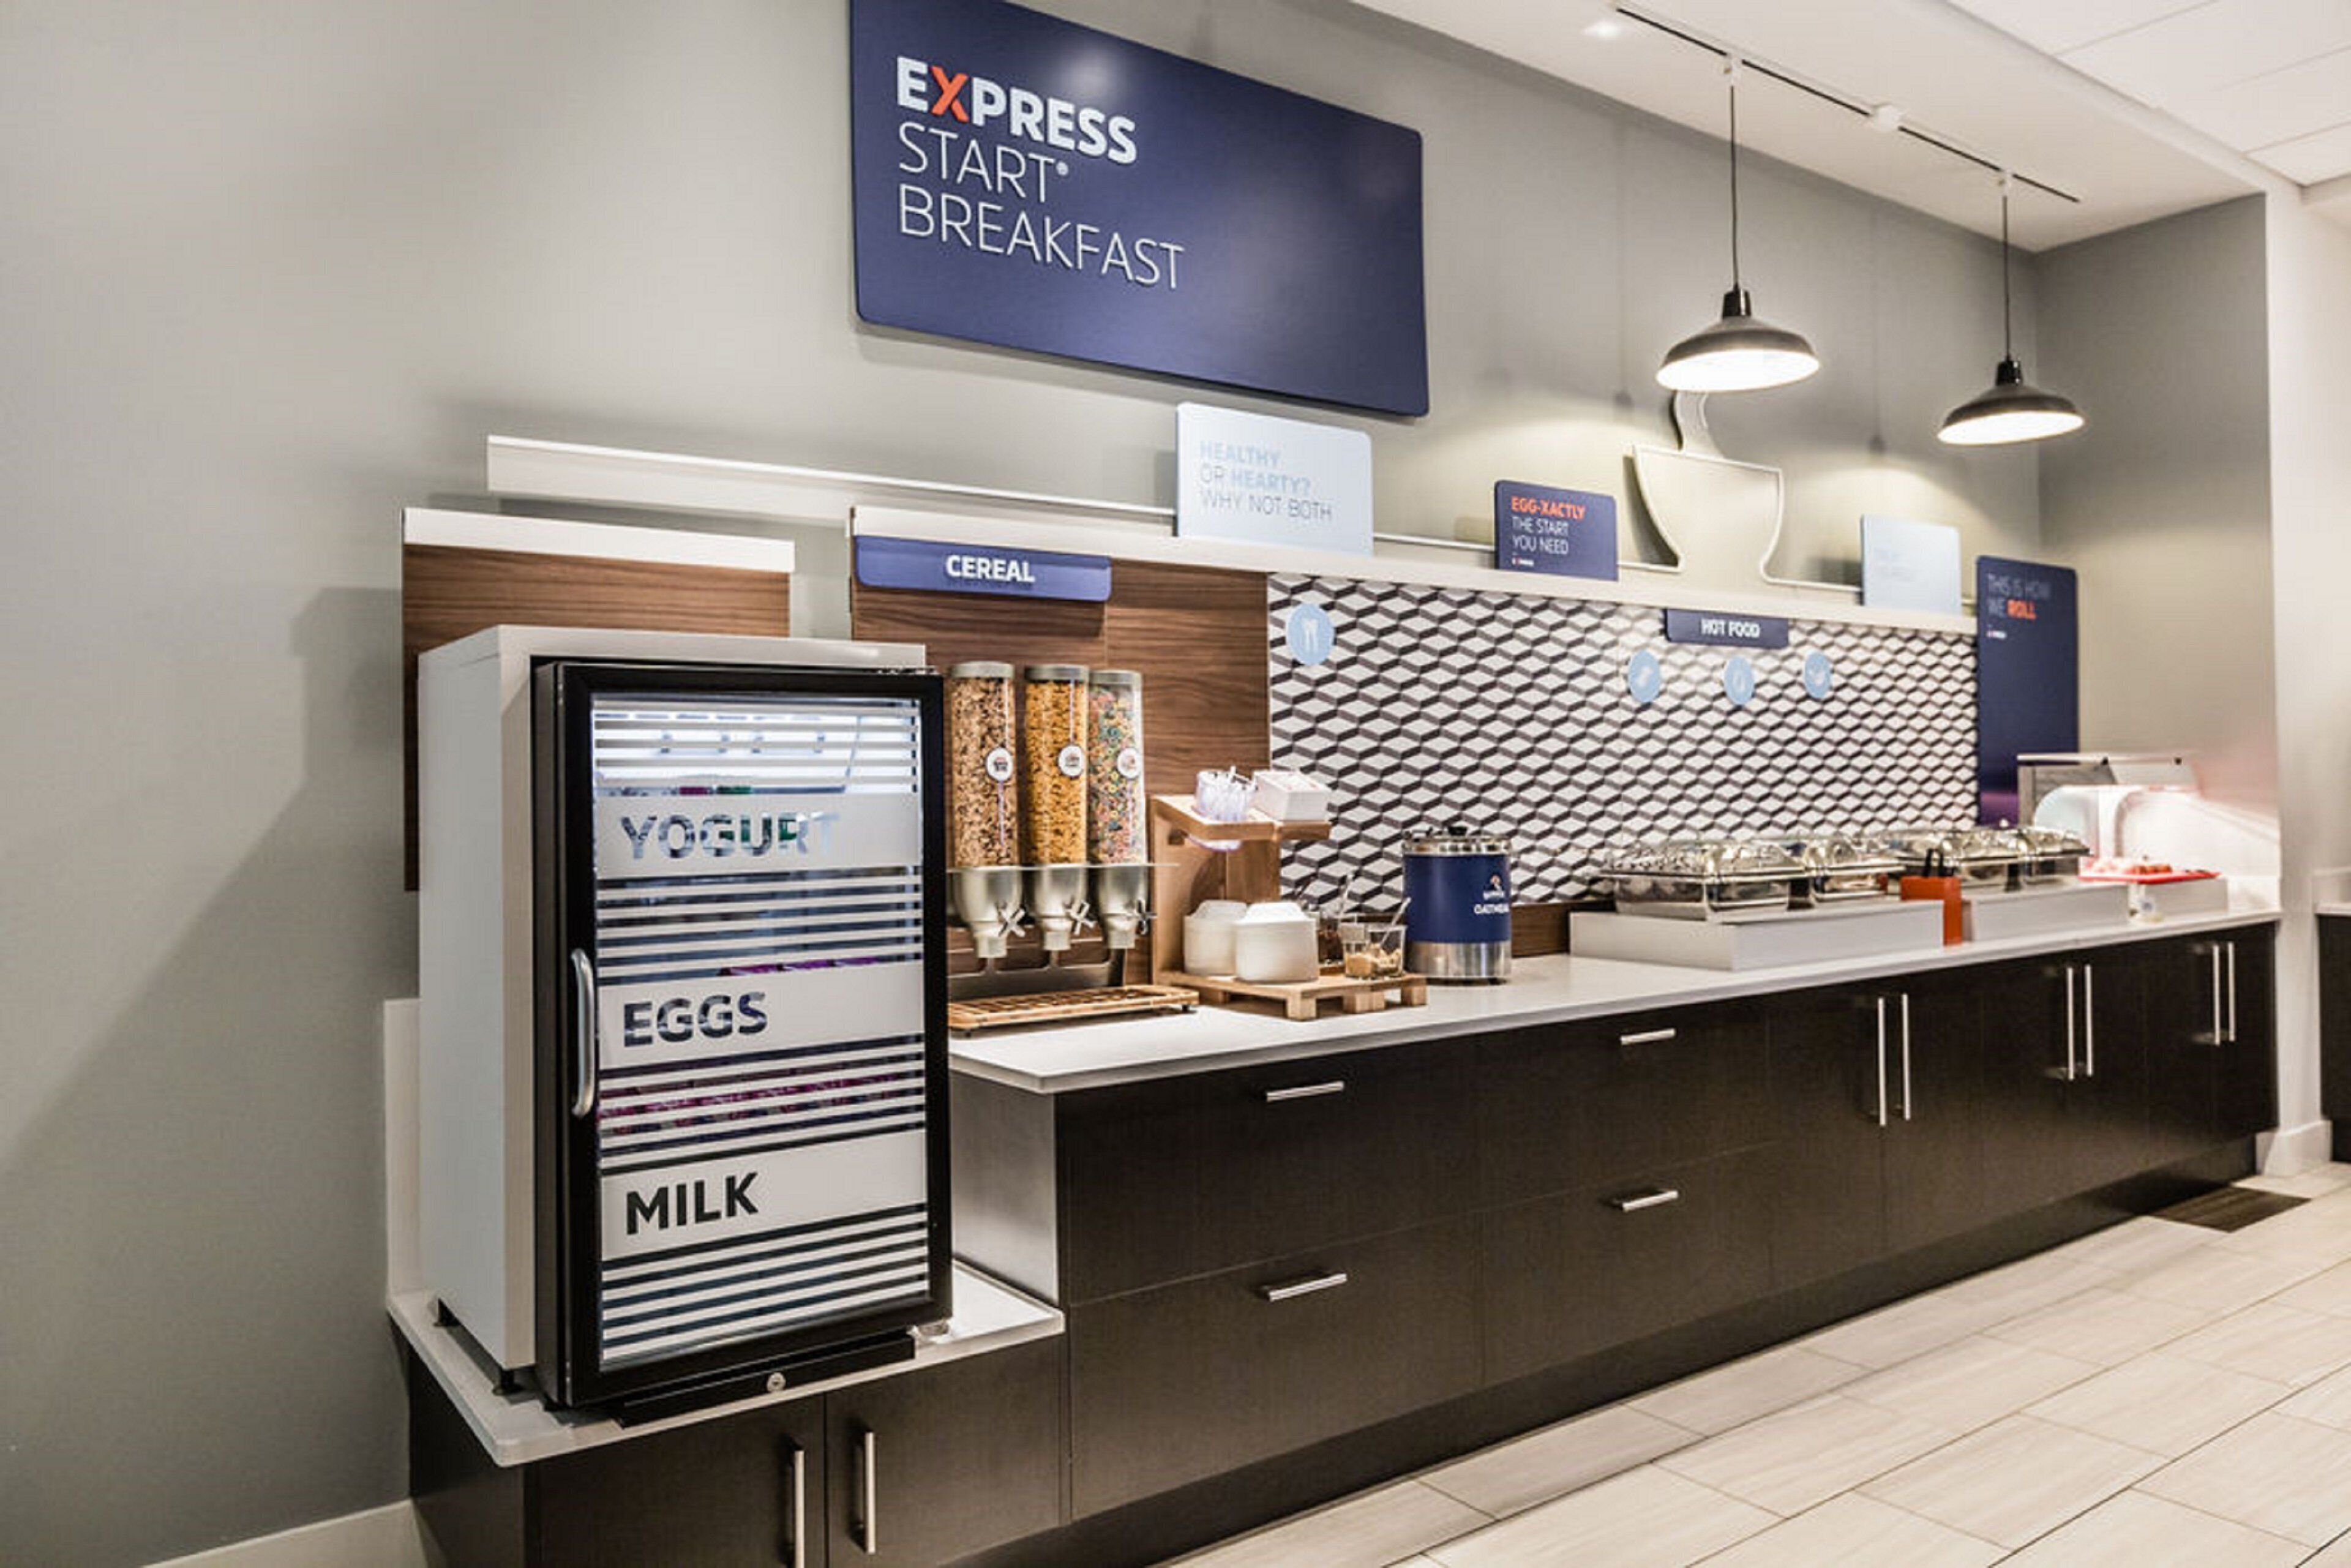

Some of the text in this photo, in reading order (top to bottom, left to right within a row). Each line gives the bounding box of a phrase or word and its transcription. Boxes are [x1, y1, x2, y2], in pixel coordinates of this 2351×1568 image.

[897, 56, 1137, 165] EXPRESS
[899, 184, 1185, 289] BREAKFAST
[1201, 440, 1281, 467] HEALTHY
[1201, 462, 1311, 495] OR HEARTY?
[1201, 487, 1333, 520] WHY NOT BOTH
[1512, 496, 1586, 520] EGG-XACTLY
[1512, 515, 1569, 537] THE START
[1512, 535, 1569, 555] YOU NEED
[946, 555, 1036, 583] CEREAL
[2007, 599, 2036, 620] ROLL
[1701, 618, 1760, 638] HOT FOOD
[621, 811, 840, 858] YOGURT
[623, 992, 768, 1047] EGGS
[626, 1171, 759, 1235] MILK
